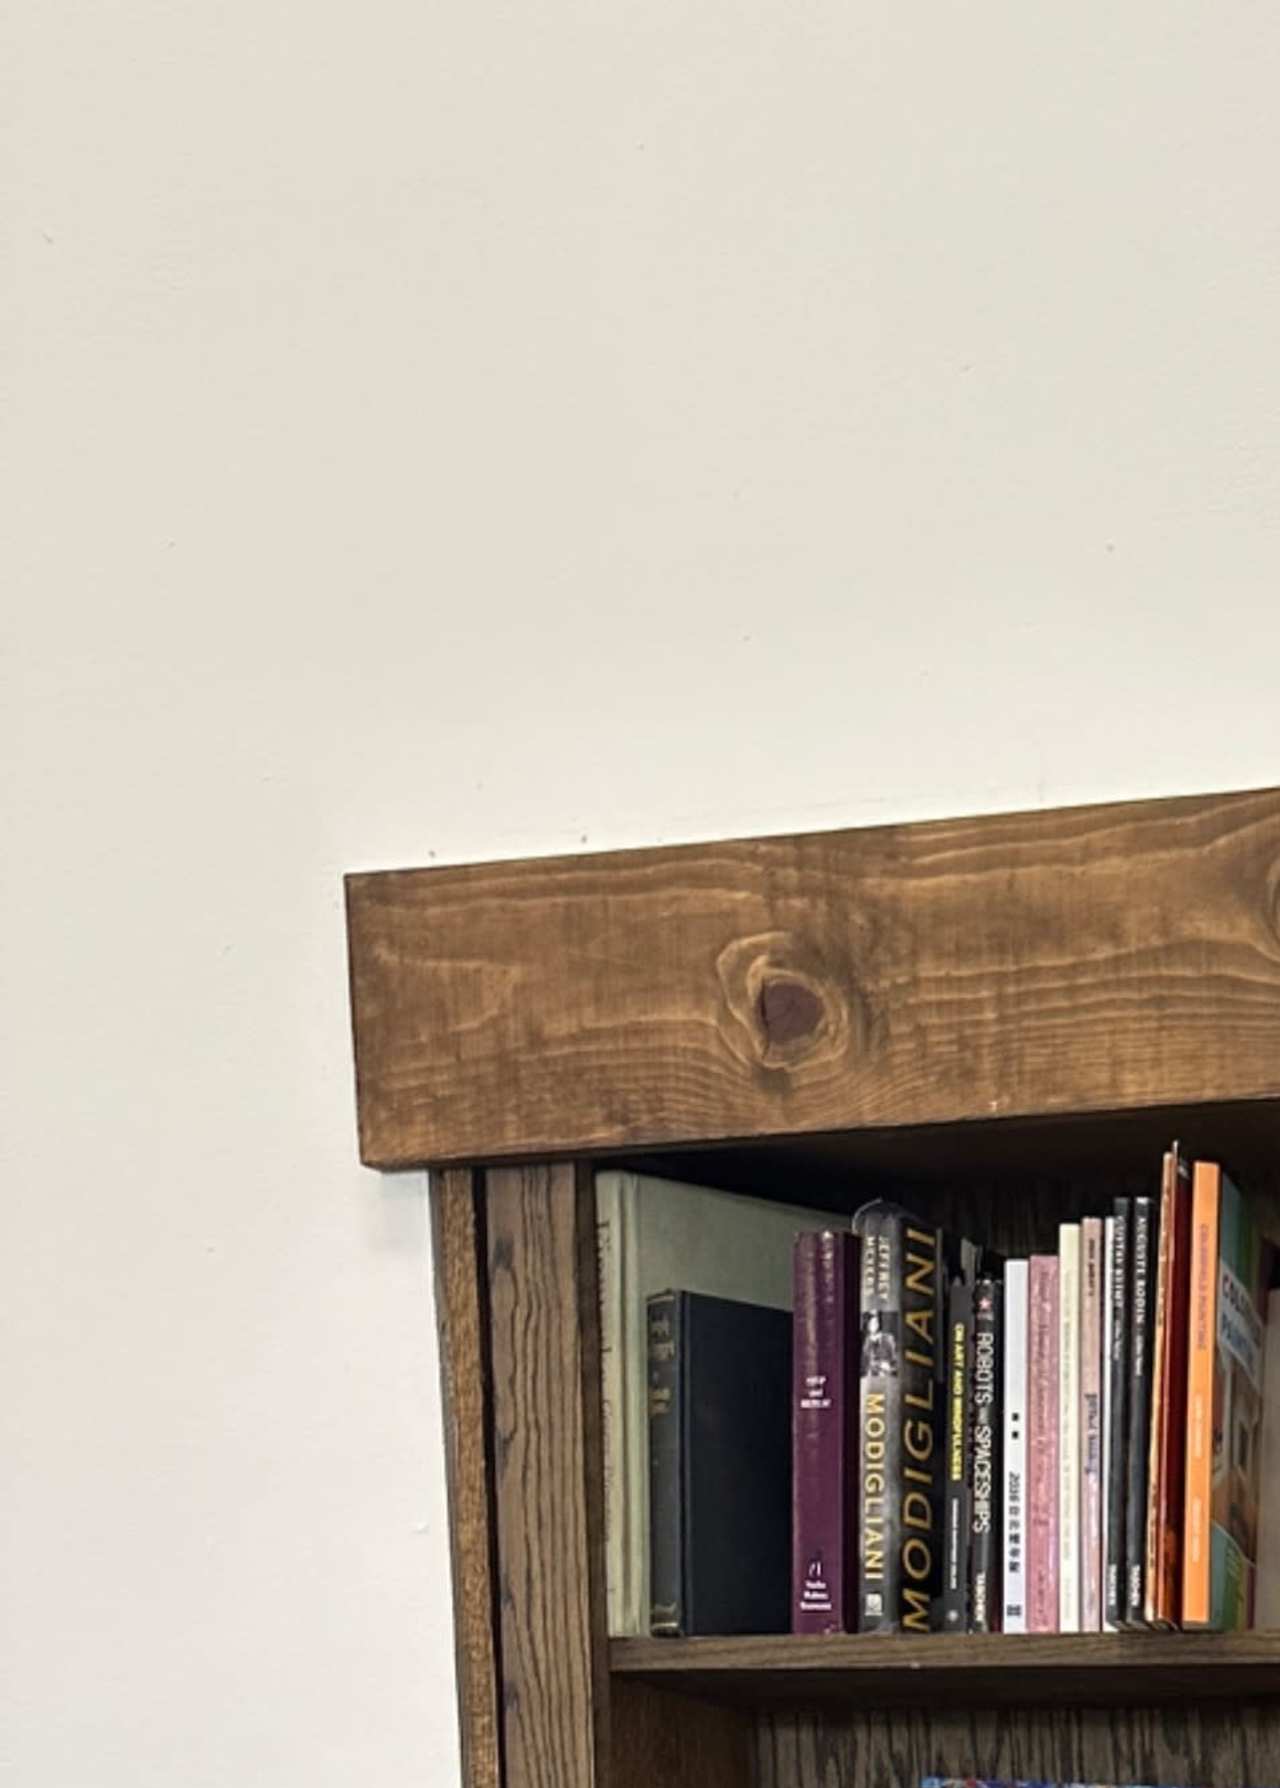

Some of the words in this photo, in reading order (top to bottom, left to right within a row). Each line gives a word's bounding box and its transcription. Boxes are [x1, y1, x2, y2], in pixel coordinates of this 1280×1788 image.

[877, 1236, 890, 1301] JEFFREY
[1135, 1278, 1147, 1324] RODIN
[953, 1344, 965, 1367] ART
[974, 1333, 994, 1405] ROBOTS
[901, 1227, 938, 1634] MODIGLIANI
[864, 1392, 886, 1581] MODIGLIANI
[972, 1425, 992, 1534] SPACESHIPS
